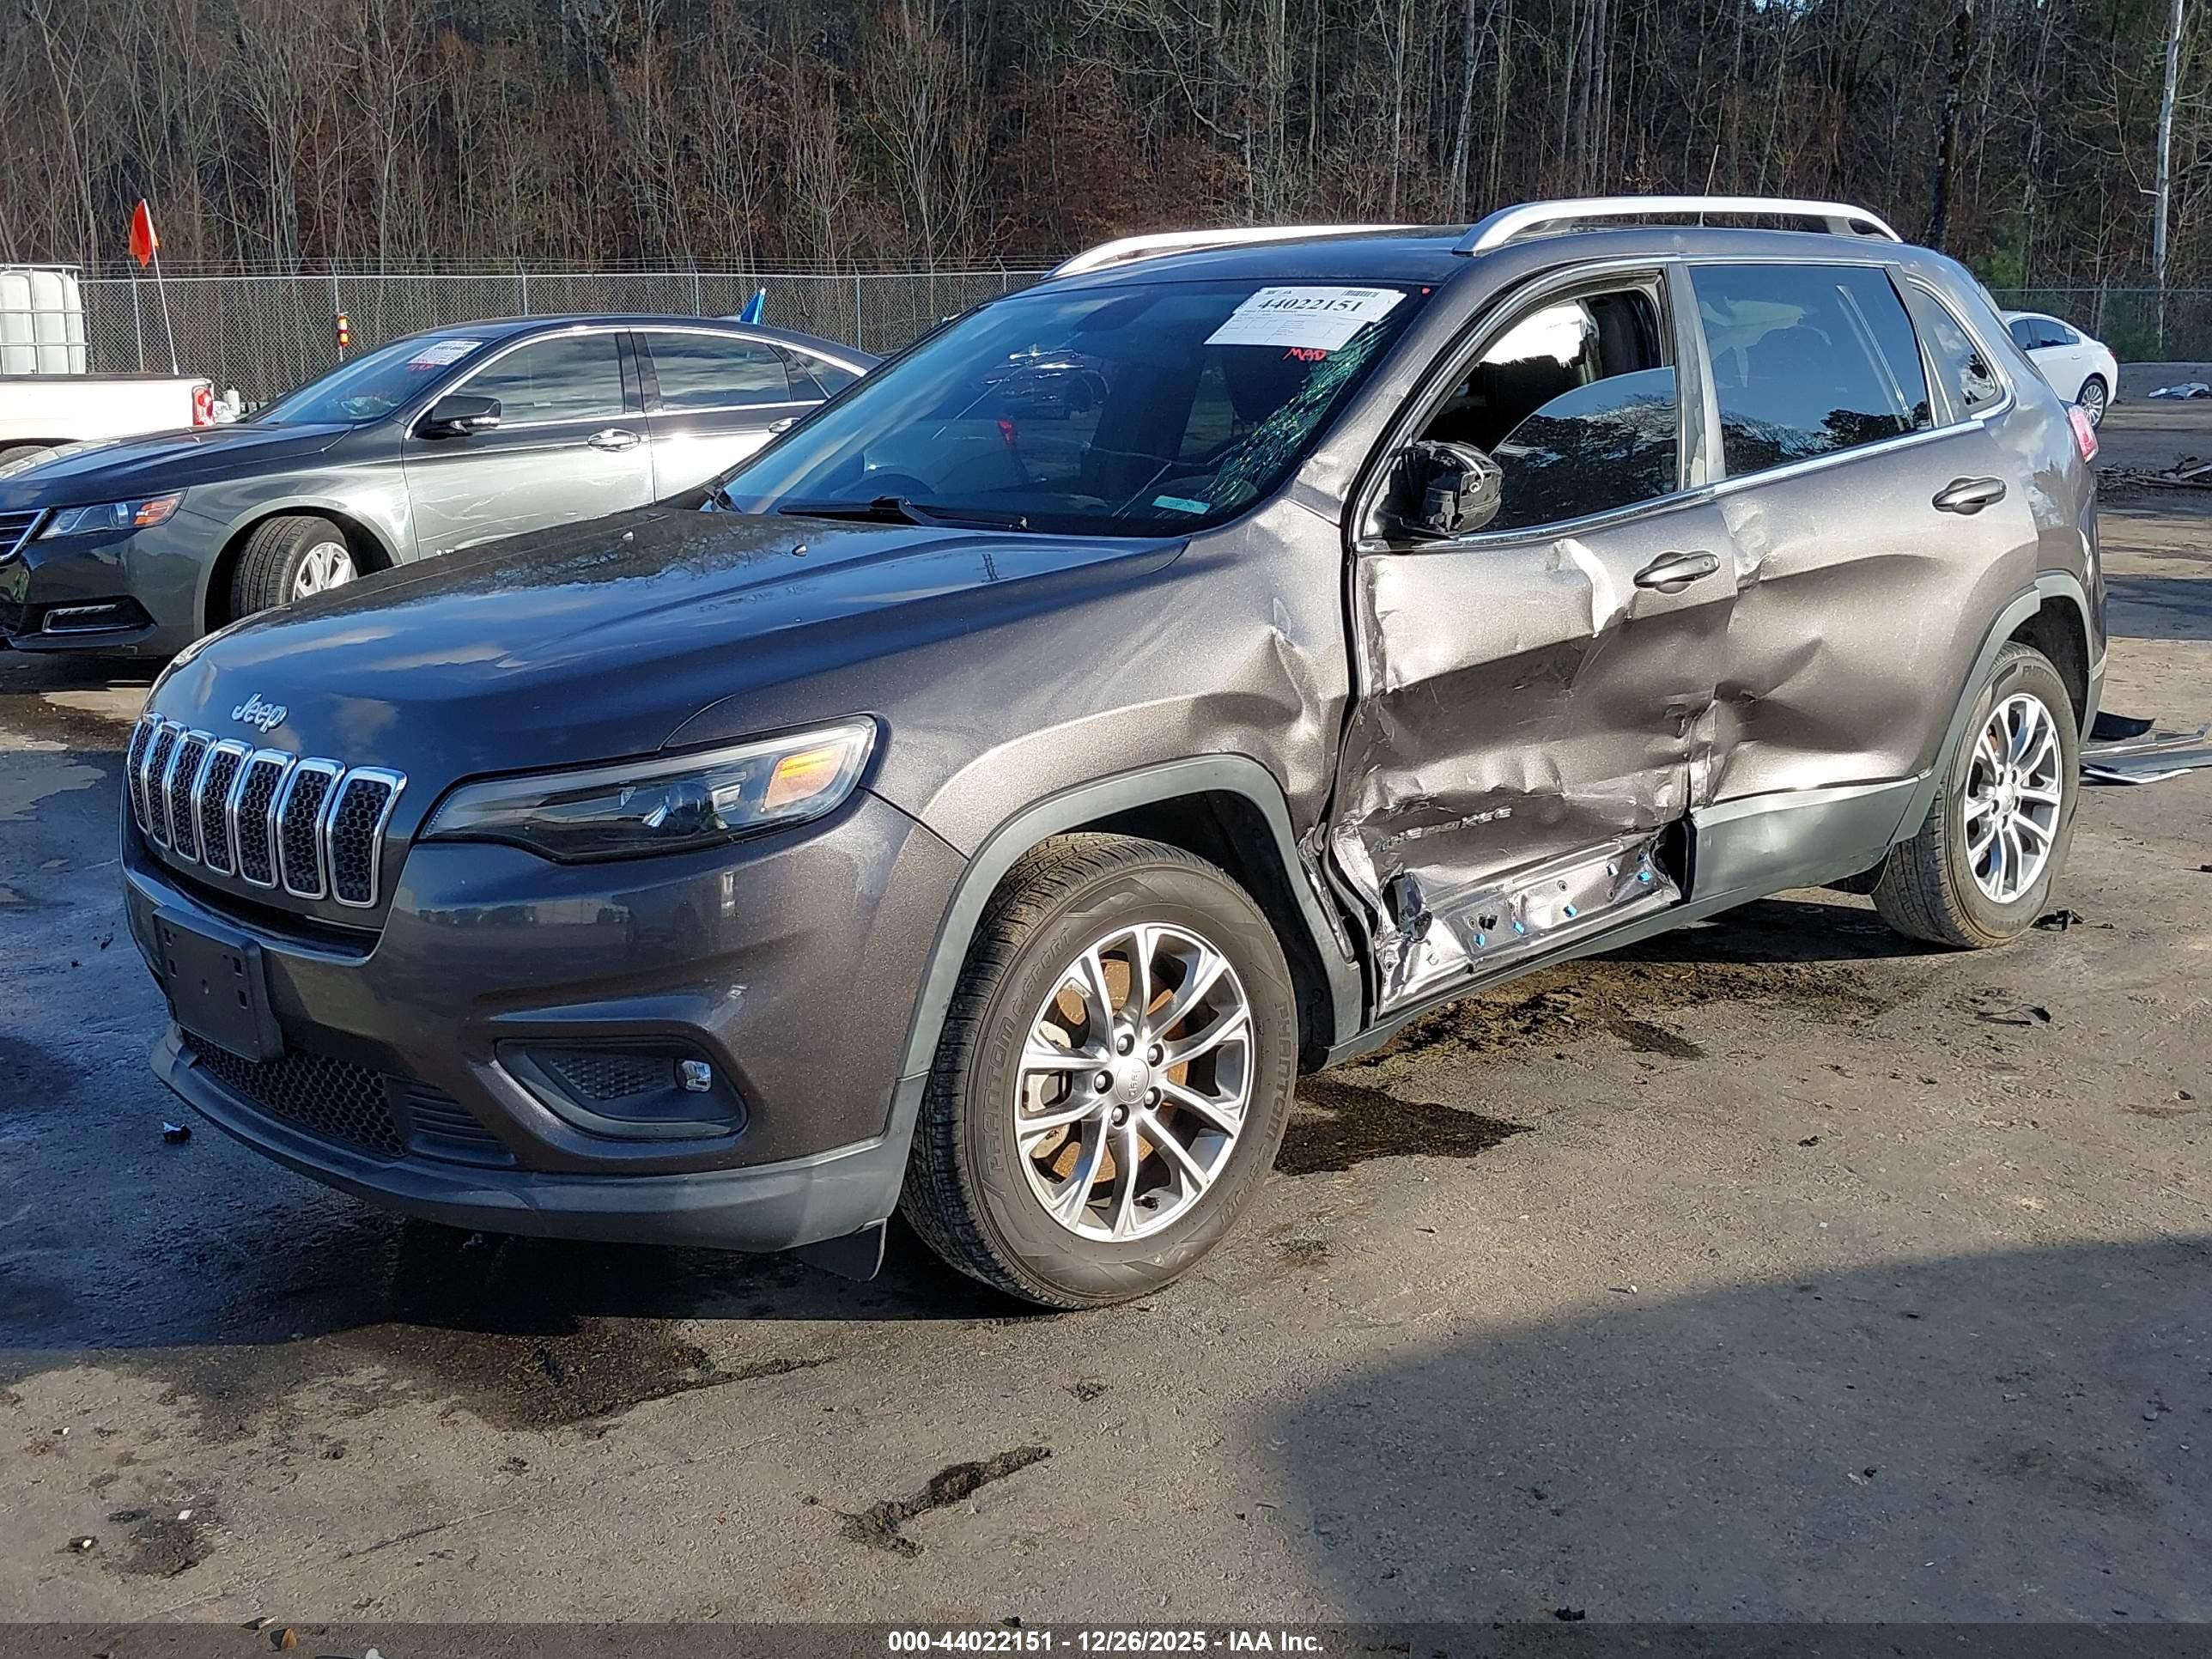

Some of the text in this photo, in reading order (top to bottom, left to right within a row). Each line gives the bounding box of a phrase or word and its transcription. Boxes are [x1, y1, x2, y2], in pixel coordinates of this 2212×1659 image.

[1257, 298, 1364, 313] 44022151
[231, 692, 289, 734] Jeep
[981, 1015, 1017, 1176] PHANTOM
[1264, 1001, 1291, 1142] PHANTOM
